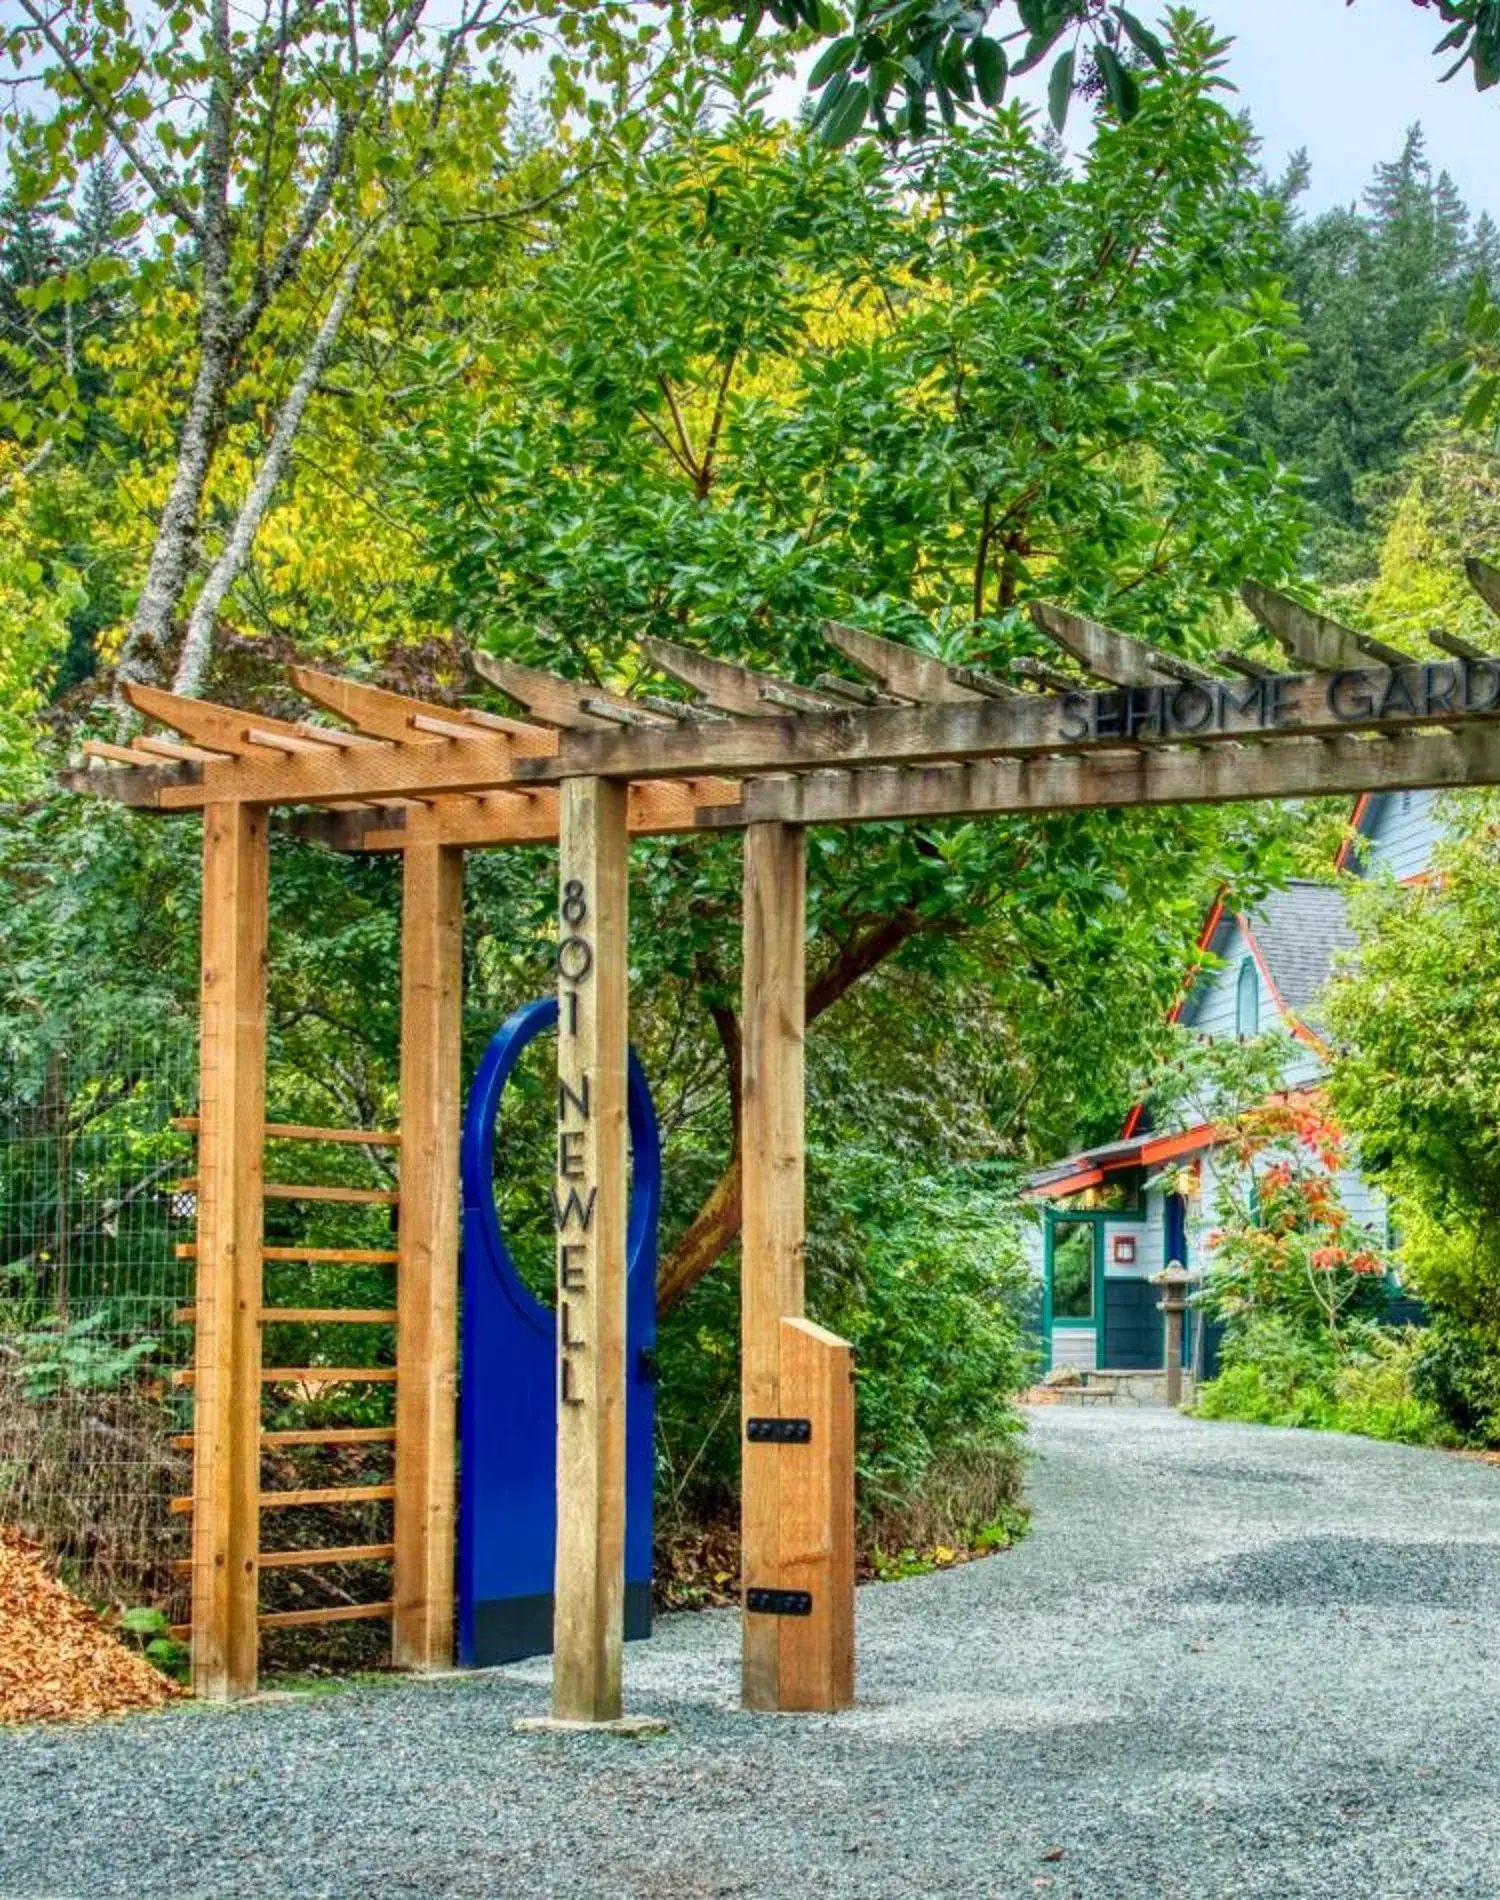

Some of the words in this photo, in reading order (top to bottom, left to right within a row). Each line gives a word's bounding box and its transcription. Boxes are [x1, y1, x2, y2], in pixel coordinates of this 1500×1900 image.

[1058, 676, 1299, 742] SEHOME
[558, 879, 592, 1036] 801
[551, 1074, 597, 1406] NEWELL
